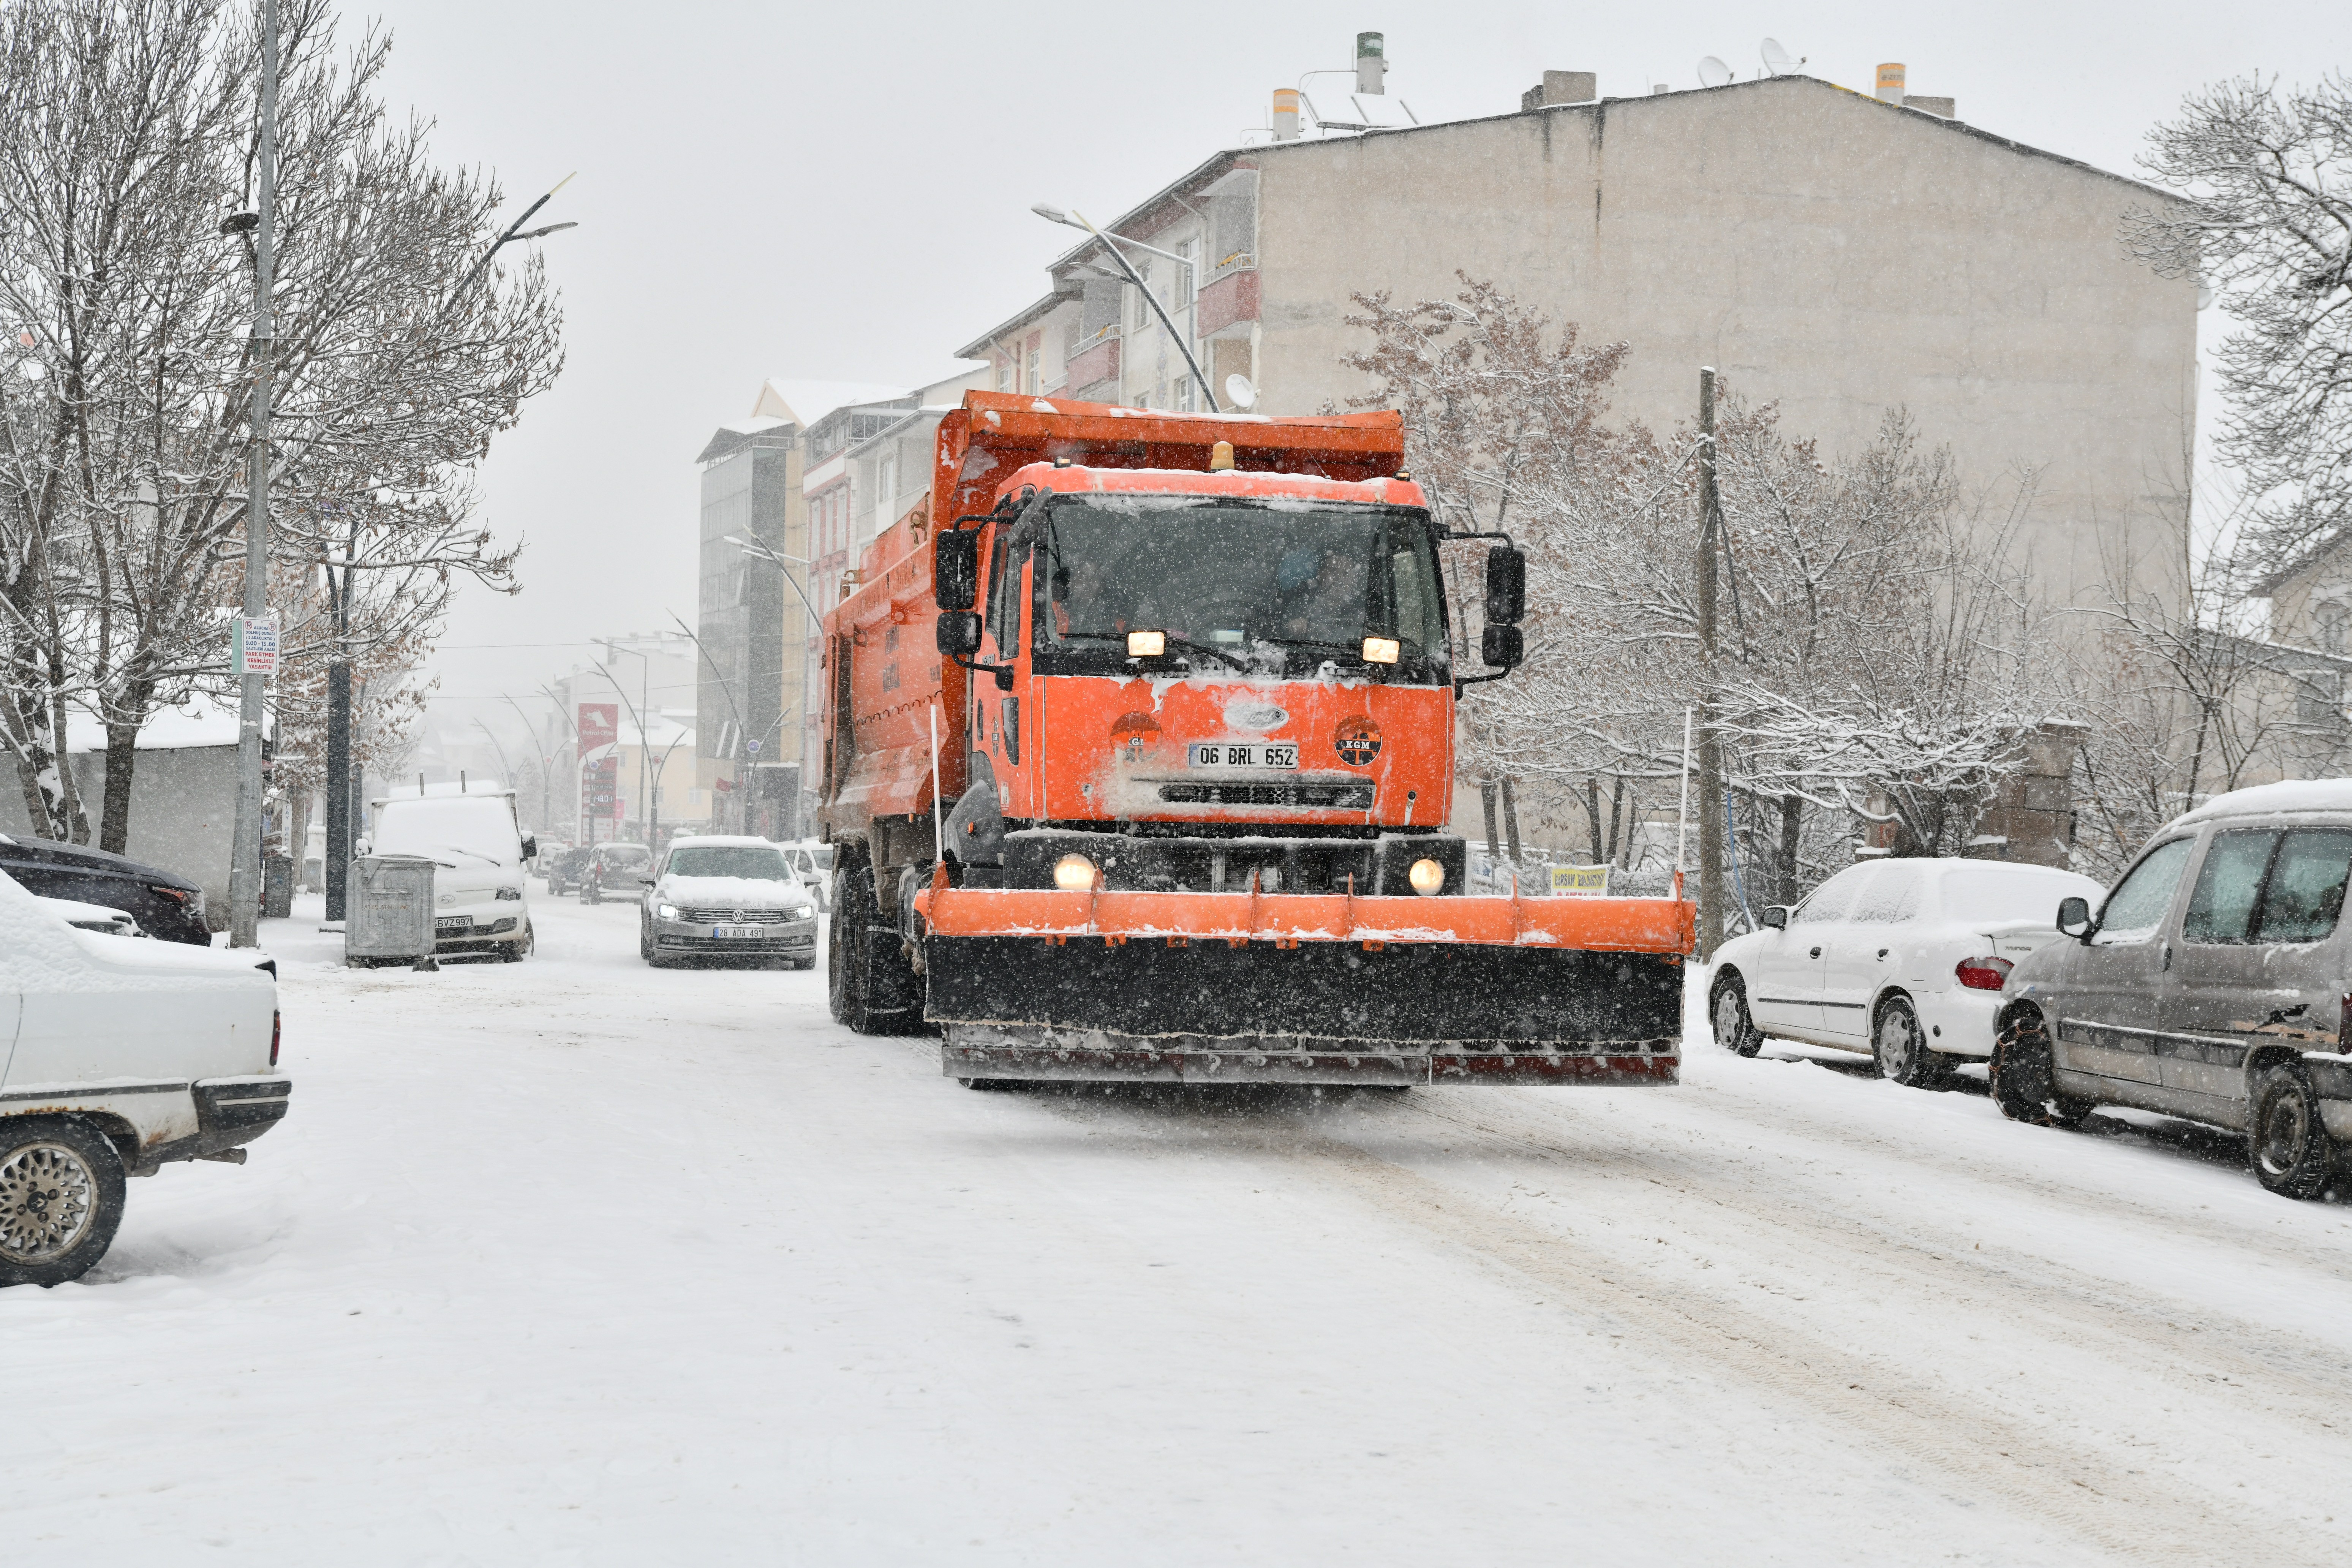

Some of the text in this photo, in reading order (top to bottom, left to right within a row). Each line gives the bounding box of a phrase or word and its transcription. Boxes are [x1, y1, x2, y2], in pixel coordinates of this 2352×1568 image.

[1346, 741, 1370, 749] KGM
[1200, 748, 1293, 765] 06 BRL 652
